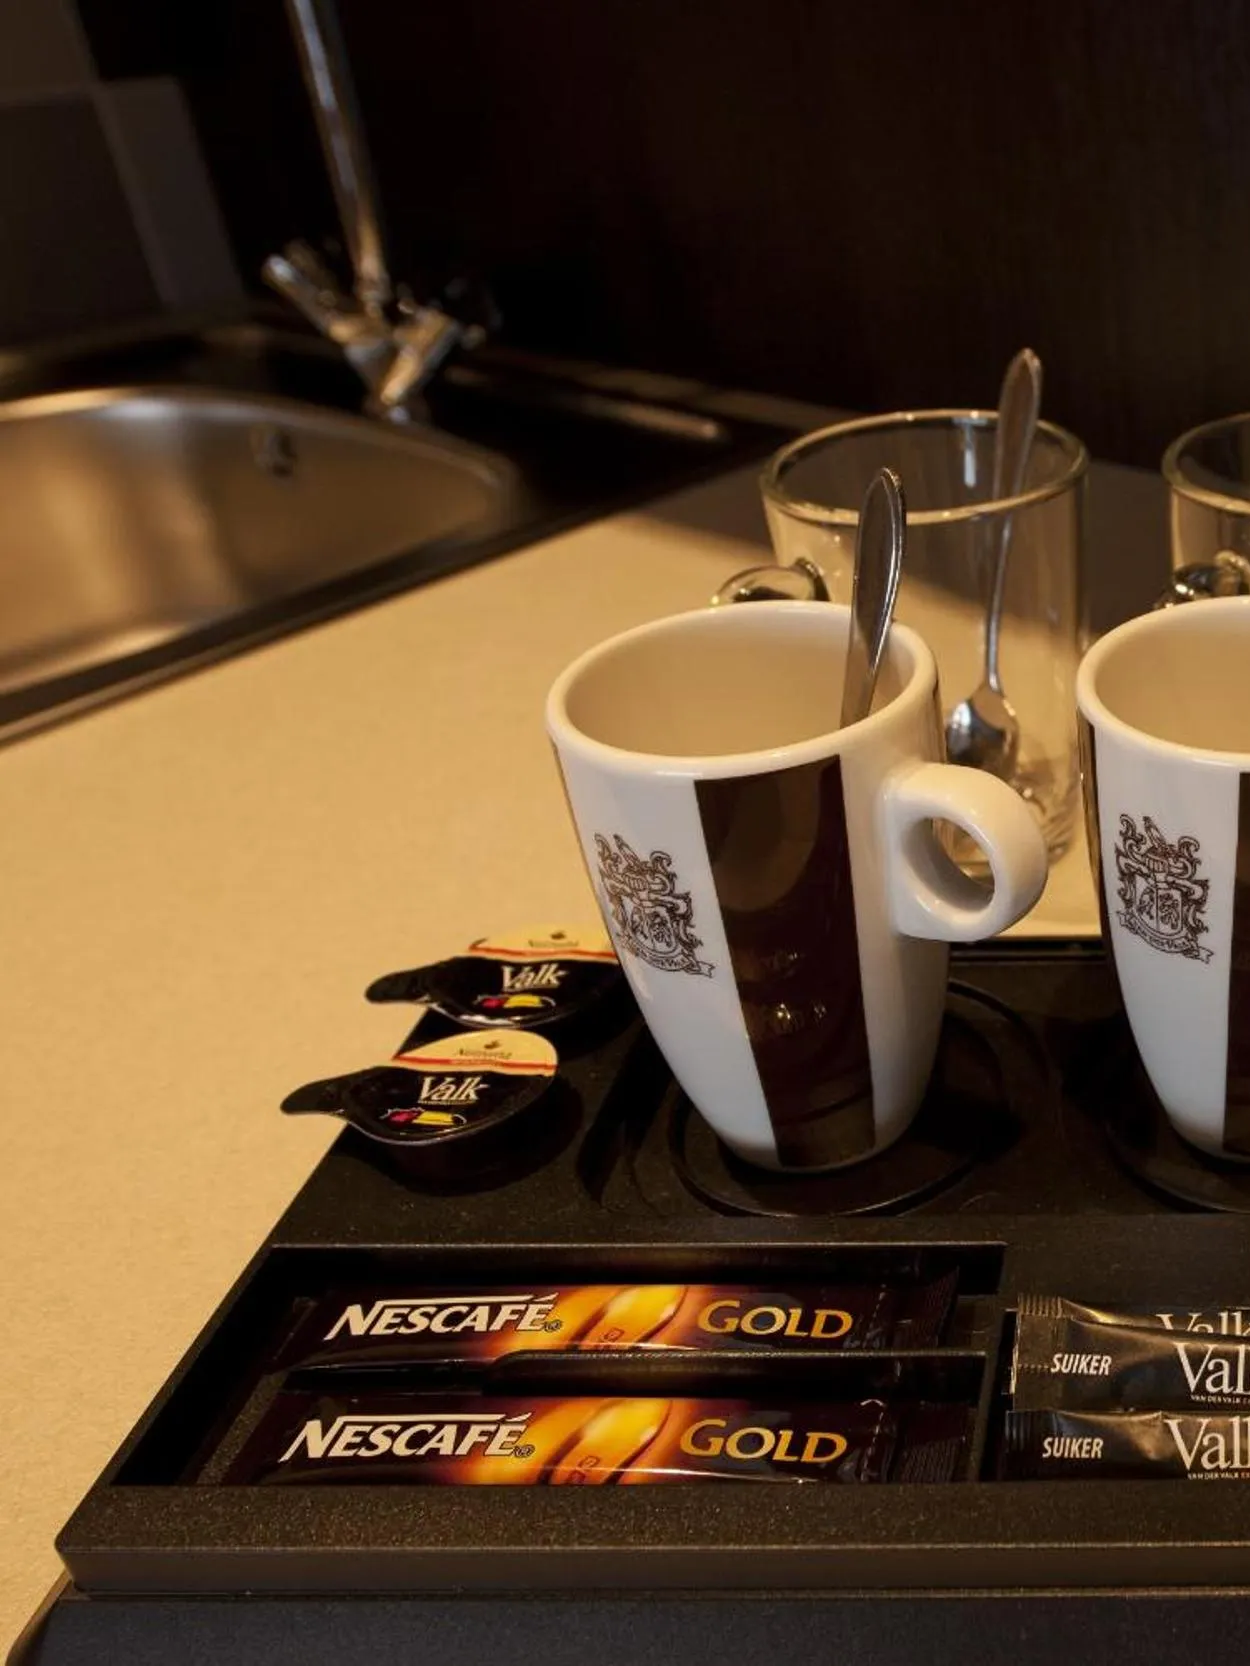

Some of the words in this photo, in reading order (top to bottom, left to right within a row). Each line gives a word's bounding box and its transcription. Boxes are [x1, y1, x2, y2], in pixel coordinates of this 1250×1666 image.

[501, 963, 570, 988] Valk
[419, 1075, 490, 1101] Valk
[323, 1292, 559, 1341] NESCAFÉ
[697, 1299, 854, 1338] GOLD
[1050, 1353, 1112, 1375] SUIKER
[278, 1412, 532, 1463] NESCAFÉ
[679, 1418, 848, 1463] GOLD
[1042, 1437, 1104, 1459] SUIKER
